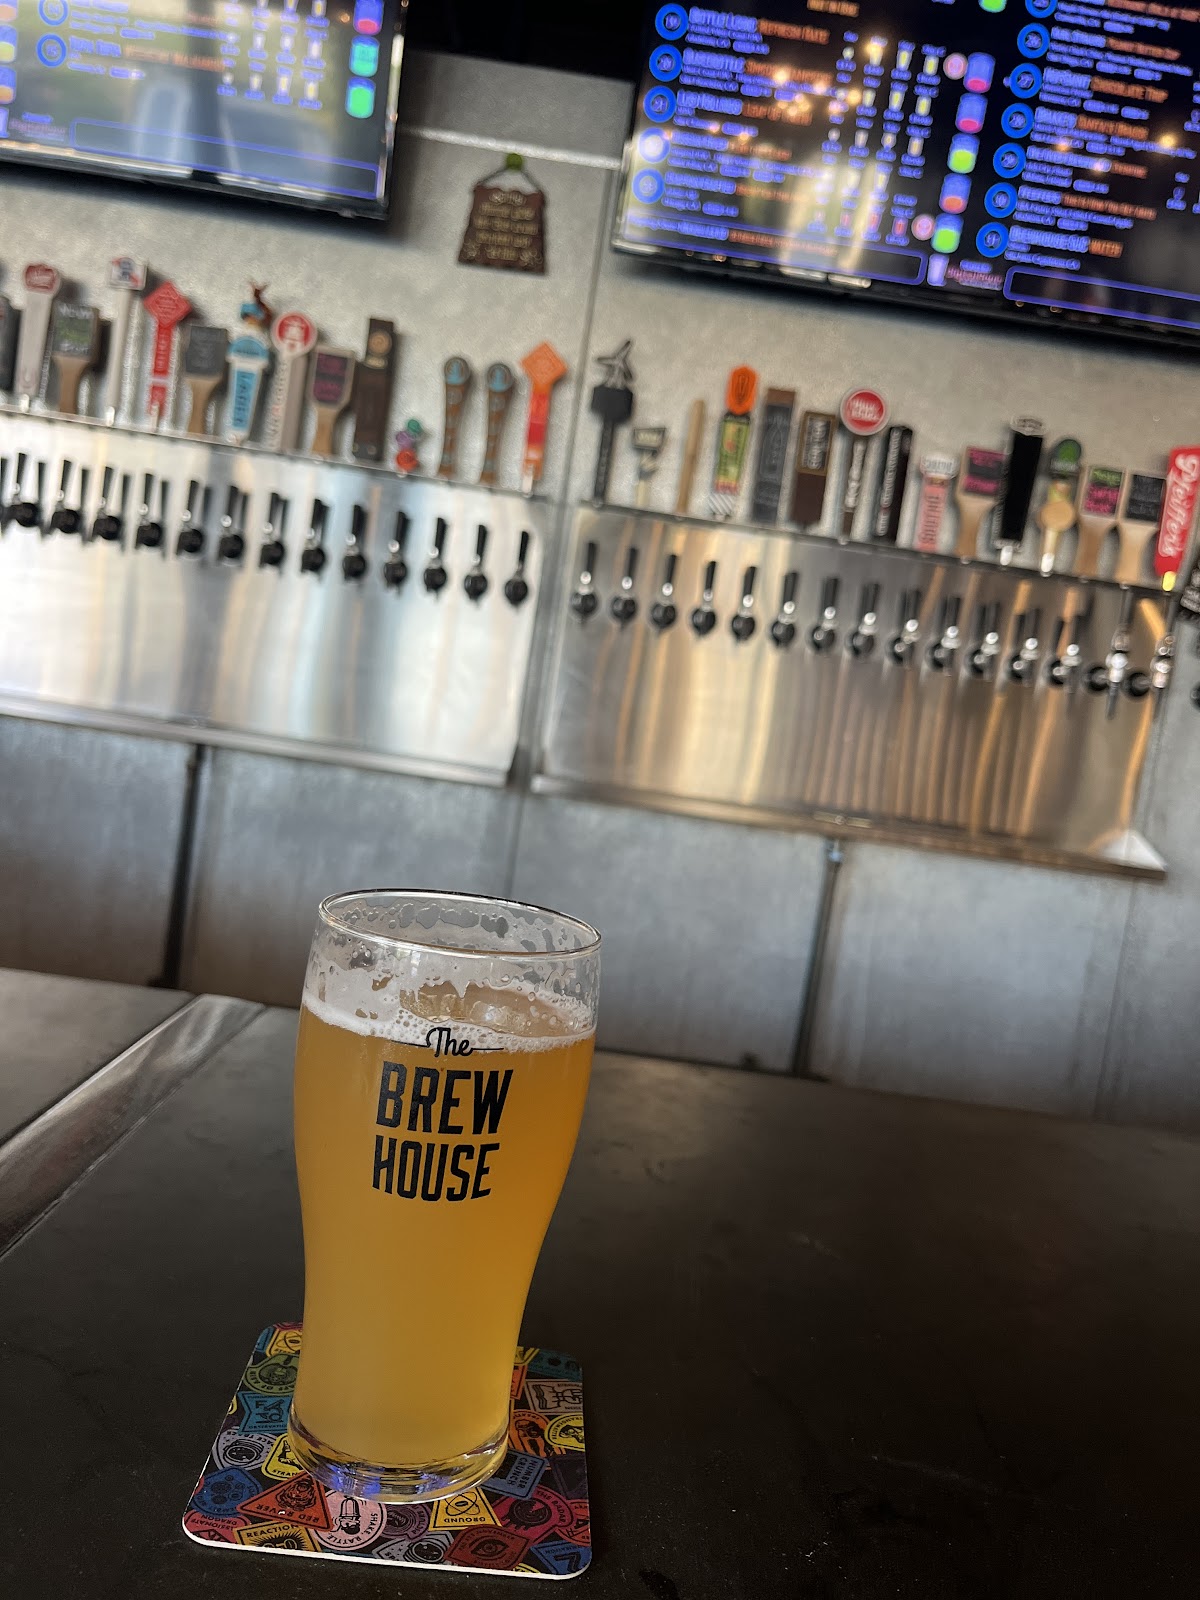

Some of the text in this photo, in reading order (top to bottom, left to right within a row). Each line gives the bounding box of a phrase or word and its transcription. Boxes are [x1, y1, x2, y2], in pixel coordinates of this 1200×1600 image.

[425, 1027, 474, 1058] The
[376, 1061, 514, 1135] BREW
[372, 1134, 500, 1202] HOUSE
[271, 1468, 302, 1477] STRAN
[507, 1457, 528, 1486] CRUNCH
[517, 1459, 538, 1489] NUMBER
[190, 1517, 235, 1531] SSIONATE
[200, 1513, 238, 1526] DRAGON
[255, 1503, 320, 1523] RED ROVER
[551, 1500, 567, 1523] RADAR
